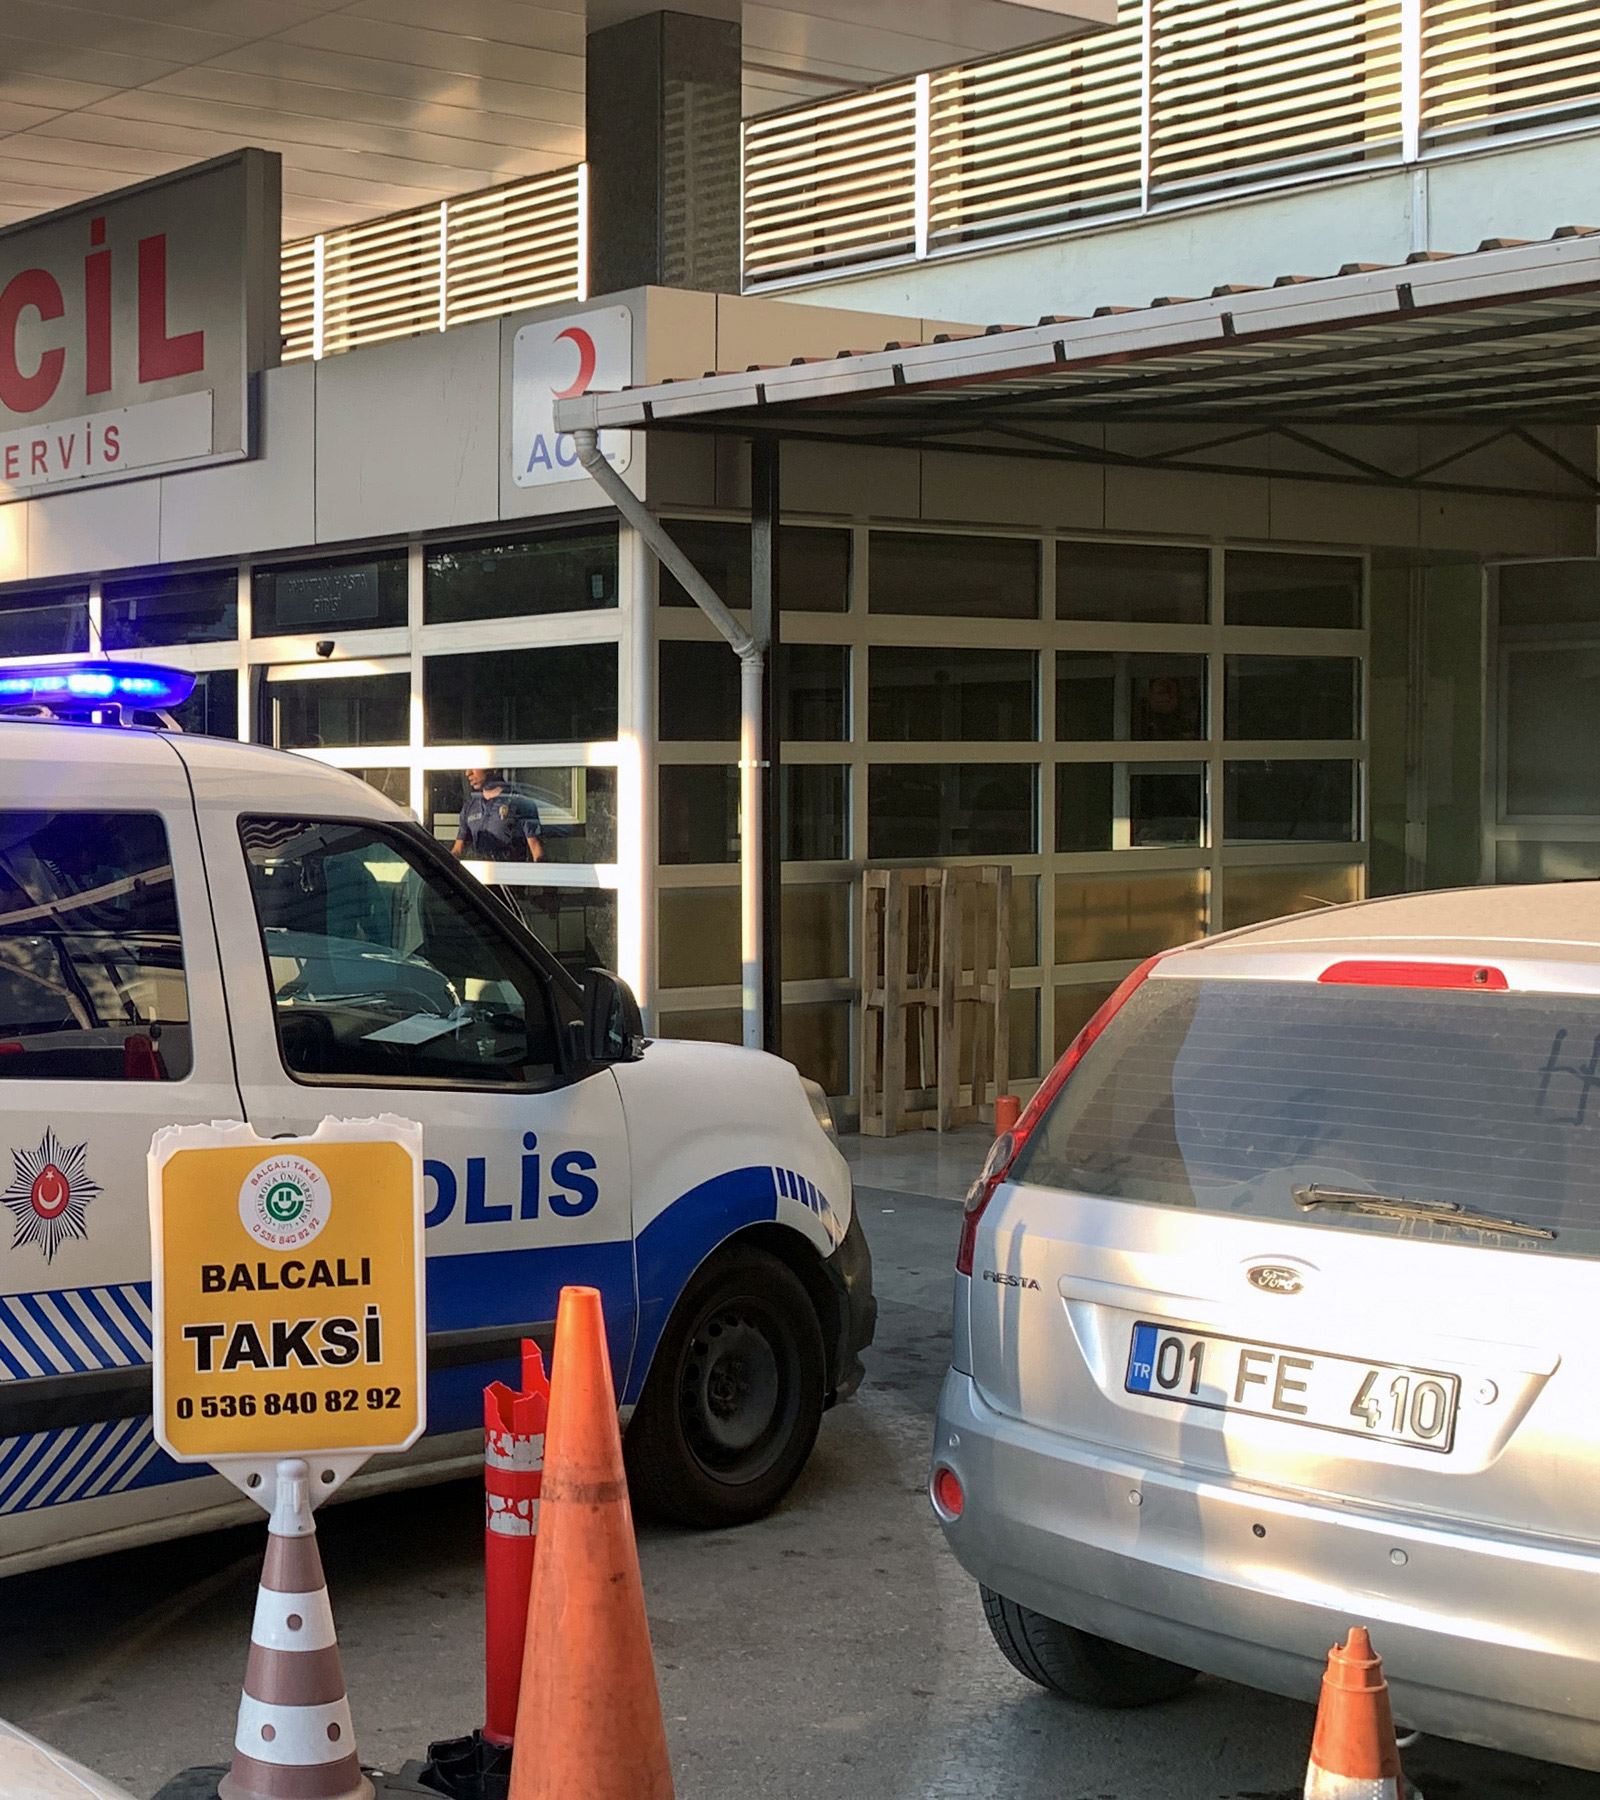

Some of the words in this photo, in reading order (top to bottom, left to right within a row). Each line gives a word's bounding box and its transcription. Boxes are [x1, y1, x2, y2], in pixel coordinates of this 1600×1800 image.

[526, 432, 616, 473] AC
[250, 1161, 290, 1186] BALCALI
[294, 1161, 321, 1183] TAKSİ
[424, 1131, 599, 1229] OLİS
[252, 1224, 261, 1232] 0
[260, 1229, 276, 1243] 536
[278, 1234, 297, 1244] 840
[297, 1228, 310, 1240] 82
[308, 1217, 321, 1230] 92
[201, 1257, 371, 1294] BALCALI
[983, 1269, 1040, 1291] FIESTA
[1257, 1268, 1301, 1291] Ford
[183, 1303, 382, 1373] TAKSİ
[176, 1397, 193, 1419] 0
[201, 1395, 256, 1418] 536
[264, 1391, 317, 1415] 840
[325, 1389, 359, 1412] 82
[366, 1387, 401, 1409] 92
[1133, 1361, 1150, 1379] TR
[1156, 1336, 1205, 1395] 01
[1234, 1348, 1314, 1415] FE
[1350, 1370, 1446, 1438] 410
